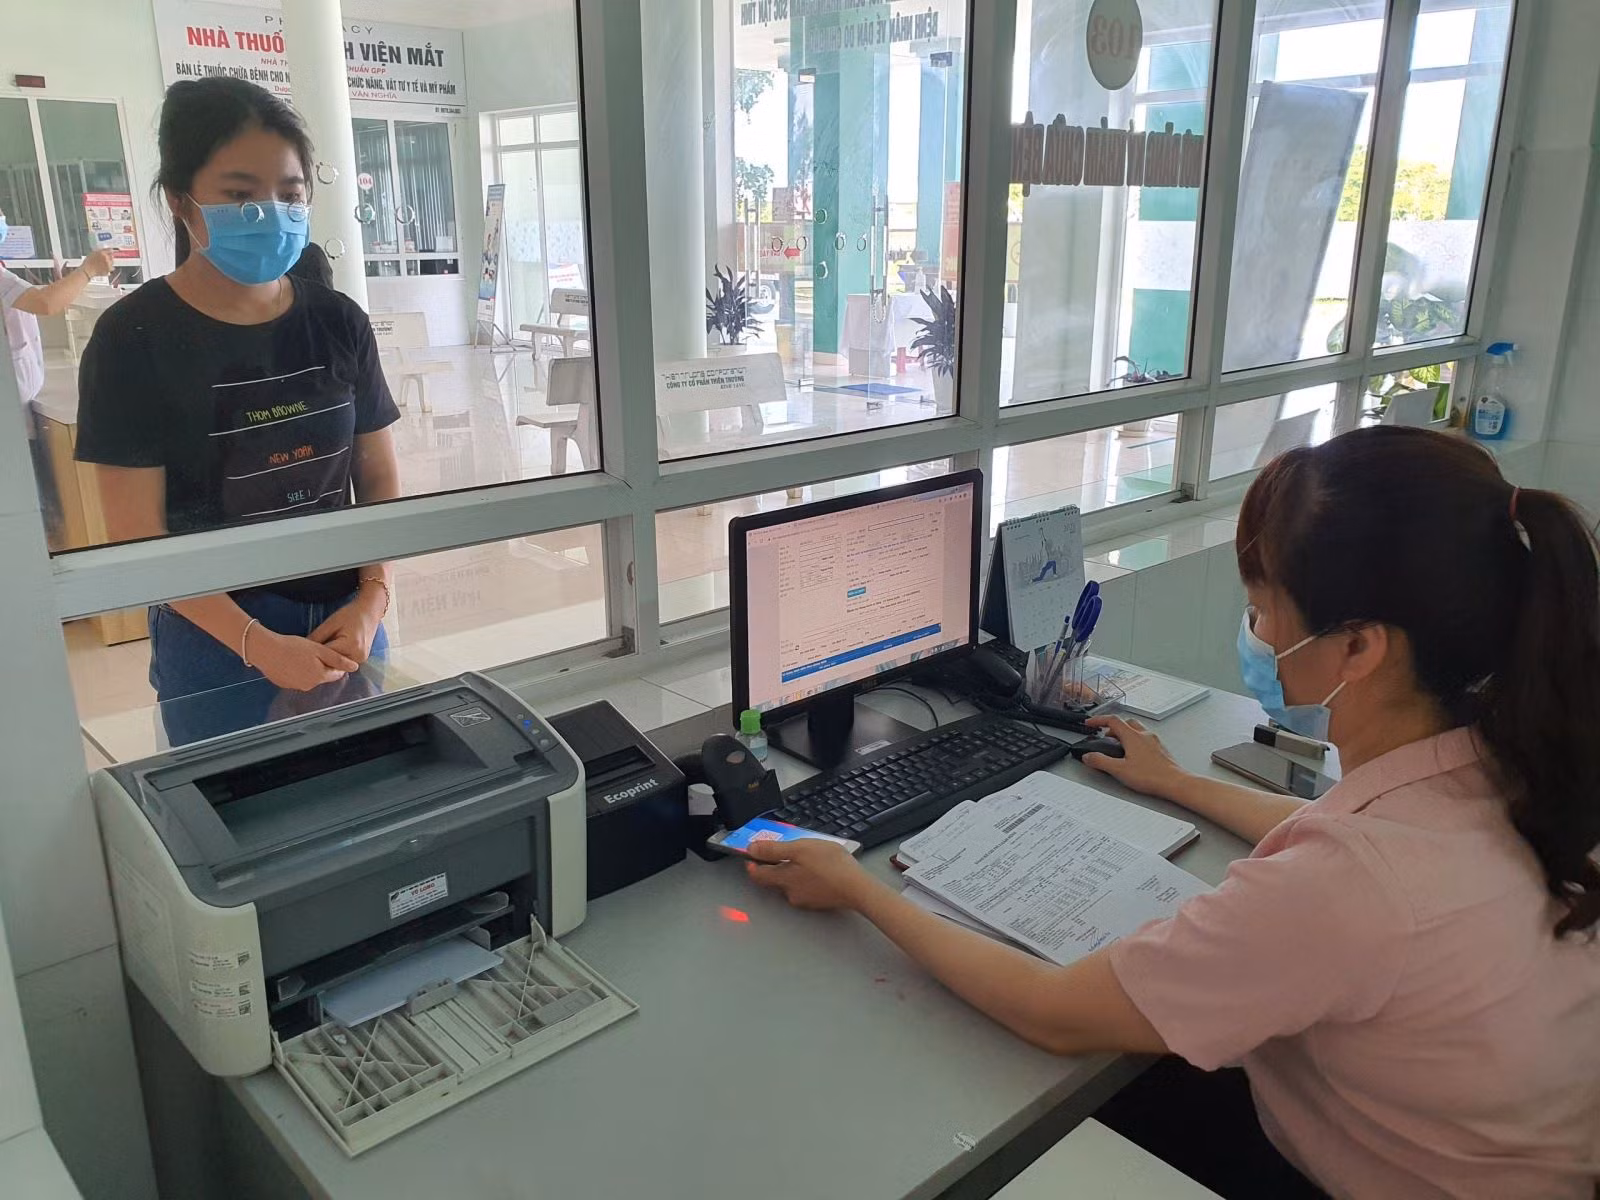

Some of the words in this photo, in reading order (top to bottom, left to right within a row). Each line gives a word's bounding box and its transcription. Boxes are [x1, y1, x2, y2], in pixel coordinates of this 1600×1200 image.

[186, 25, 231, 49] NHÀ
[235, 29, 286, 54] THUỐ
[359, 40, 402, 66] VIỆN
[407, 42, 444, 67] MẮT
[246, 410, 271, 423] THOM
[272, 400, 309, 418] BROWNE
[269, 452, 289, 464] NEW
[292, 445, 314, 460] YORK
[287, 489, 305, 503] SIZE
[603, 777, 660, 805] Ecoprint
